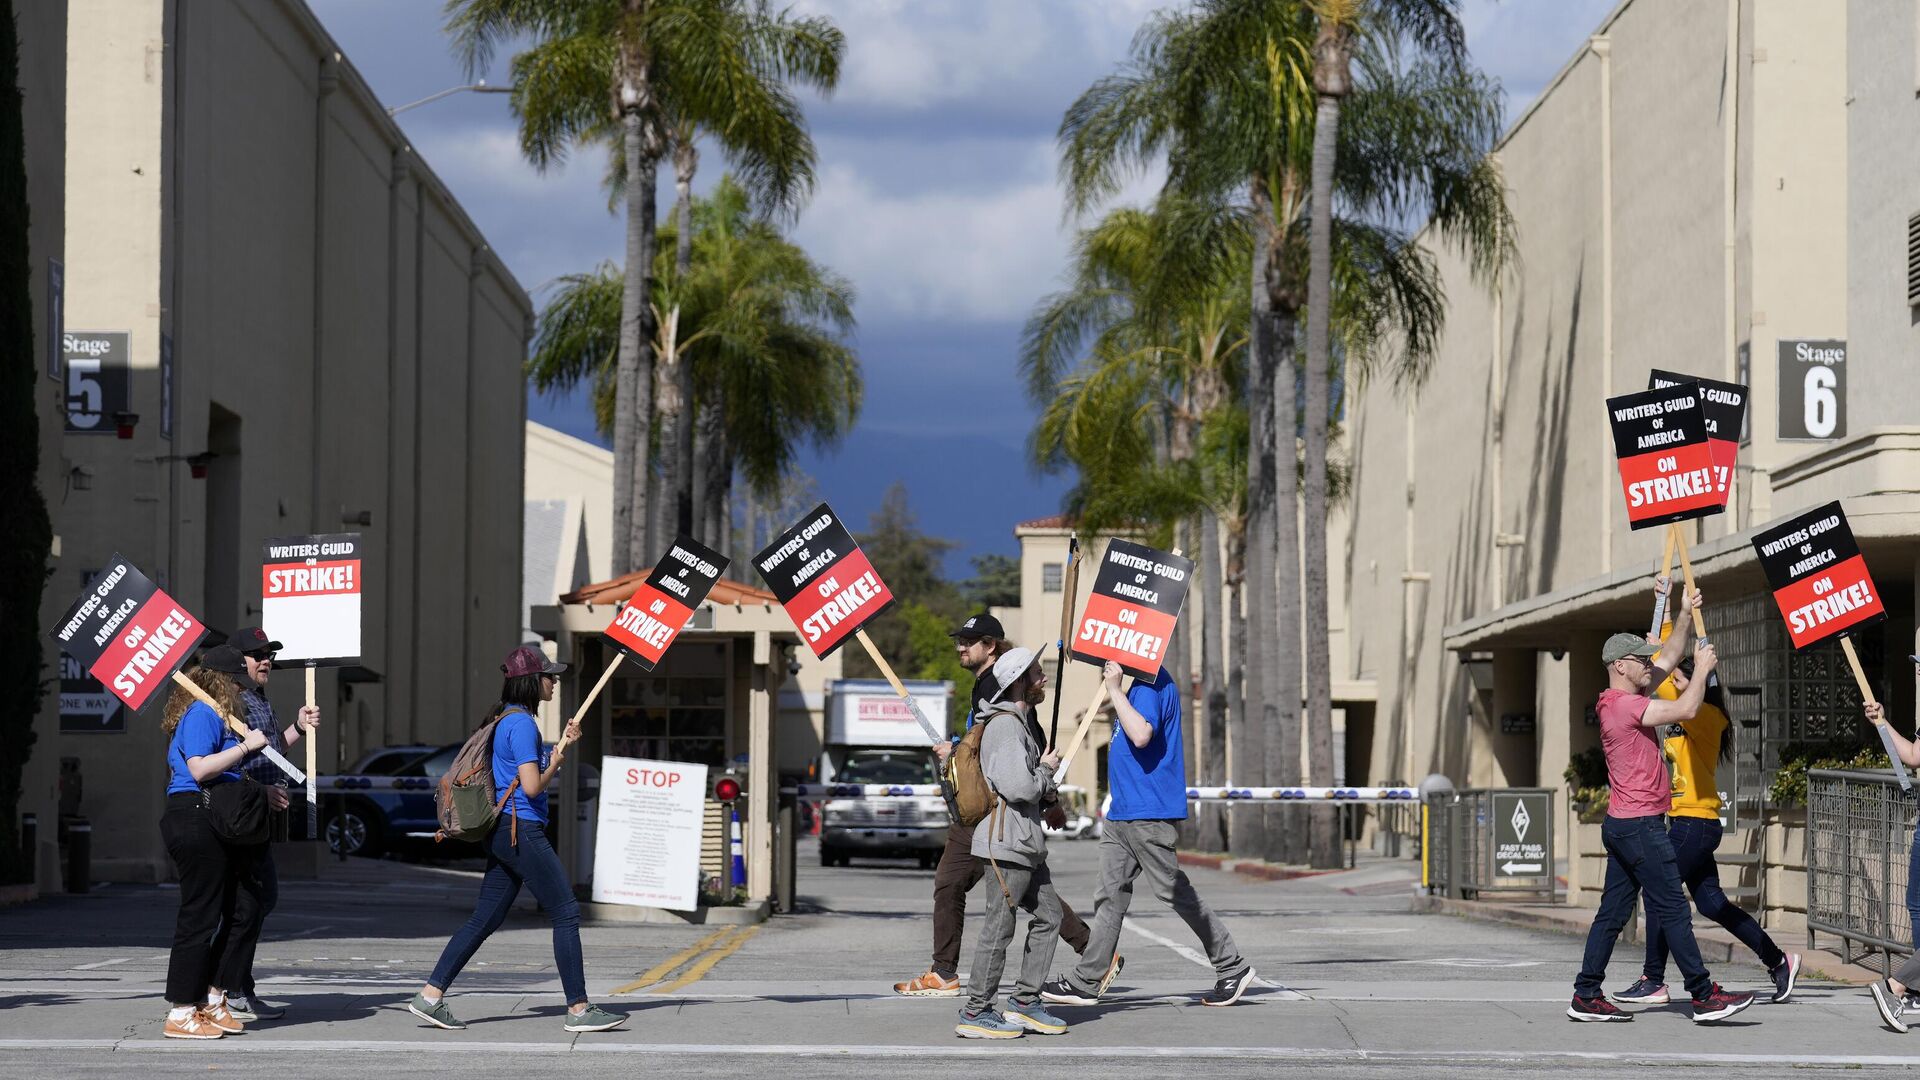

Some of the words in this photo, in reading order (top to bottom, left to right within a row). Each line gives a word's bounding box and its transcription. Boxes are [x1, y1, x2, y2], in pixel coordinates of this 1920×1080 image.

[63, 334, 110, 356] Stage
[1796, 343, 1844, 365] Stage
[68, 359, 102, 428] 5
[1707, 389, 1740, 405] GUILD
[1804, 366, 1837, 438] 6
[1615, 402, 1664, 421] WRITERS
[1665, 397, 1695, 412] GUILD
[1653, 418, 1663, 429] OF
[1638, 429, 1685, 448] AMERICA
[1658, 456, 1677, 472] ON
[1629, 468, 1712, 507] STRIKE!
[761, 535, 805, 572] WRITERS
[802, 514, 832, 540] GUILD
[1762, 529, 1809, 556] WRITERS
[1809, 515, 1840, 536] GUILD
[270, 544, 319, 559] WRITERS
[321, 542, 354, 555] GUILD
[799, 548, 810, 561] OF
[1801, 544, 1812, 555] OF
[305, 558, 317, 566] ON
[670, 545, 699, 566] WRITERS
[696, 561, 719, 578] GUILD
[679, 568, 689, 577] OF
[793, 549, 836, 587] AMERICA
[1110, 551, 1153, 571] WRITERS
[1154, 563, 1185, 581] GUILD
[1790, 549, 1836, 577] AMERICA
[269, 565, 353, 594] STRIKE!
[659, 575, 690, 598] AMERICA
[819, 577, 839, 597] ON
[1135, 574, 1147, 584] OF
[1813, 577, 1834, 595] ON
[59, 594, 101, 641] WRITERS
[97, 565, 127, 597] GUILD
[1113, 582, 1158, 604] AMERICA
[97, 605, 109, 618] OF
[650, 599, 667, 614] ON
[803, 571, 881, 642] STRIKE!
[1118, 609, 1138, 625] ON
[1789, 580, 1873, 634] STRIKE!
[94, 598, 138, 647] AMERICA
[616, 606, 674, 650] STRIKE!
[125, 625, 146, 648] ON
[1080, 618, 1163, 660] STRIKE!
[114, 608, 192, 698] STRIKE!
[85, 699, 110, 709] WAY
[626, 768, 681, 788] STOP
[1497, 851, 1523, 859] DECAL
[1524, 851, 1545, 860] ONLY
[1501, 844, 1520, 852] FAST
[1521, 844, 1542, 852] PASS
[979, 1020, 998, 1029] HOKA
